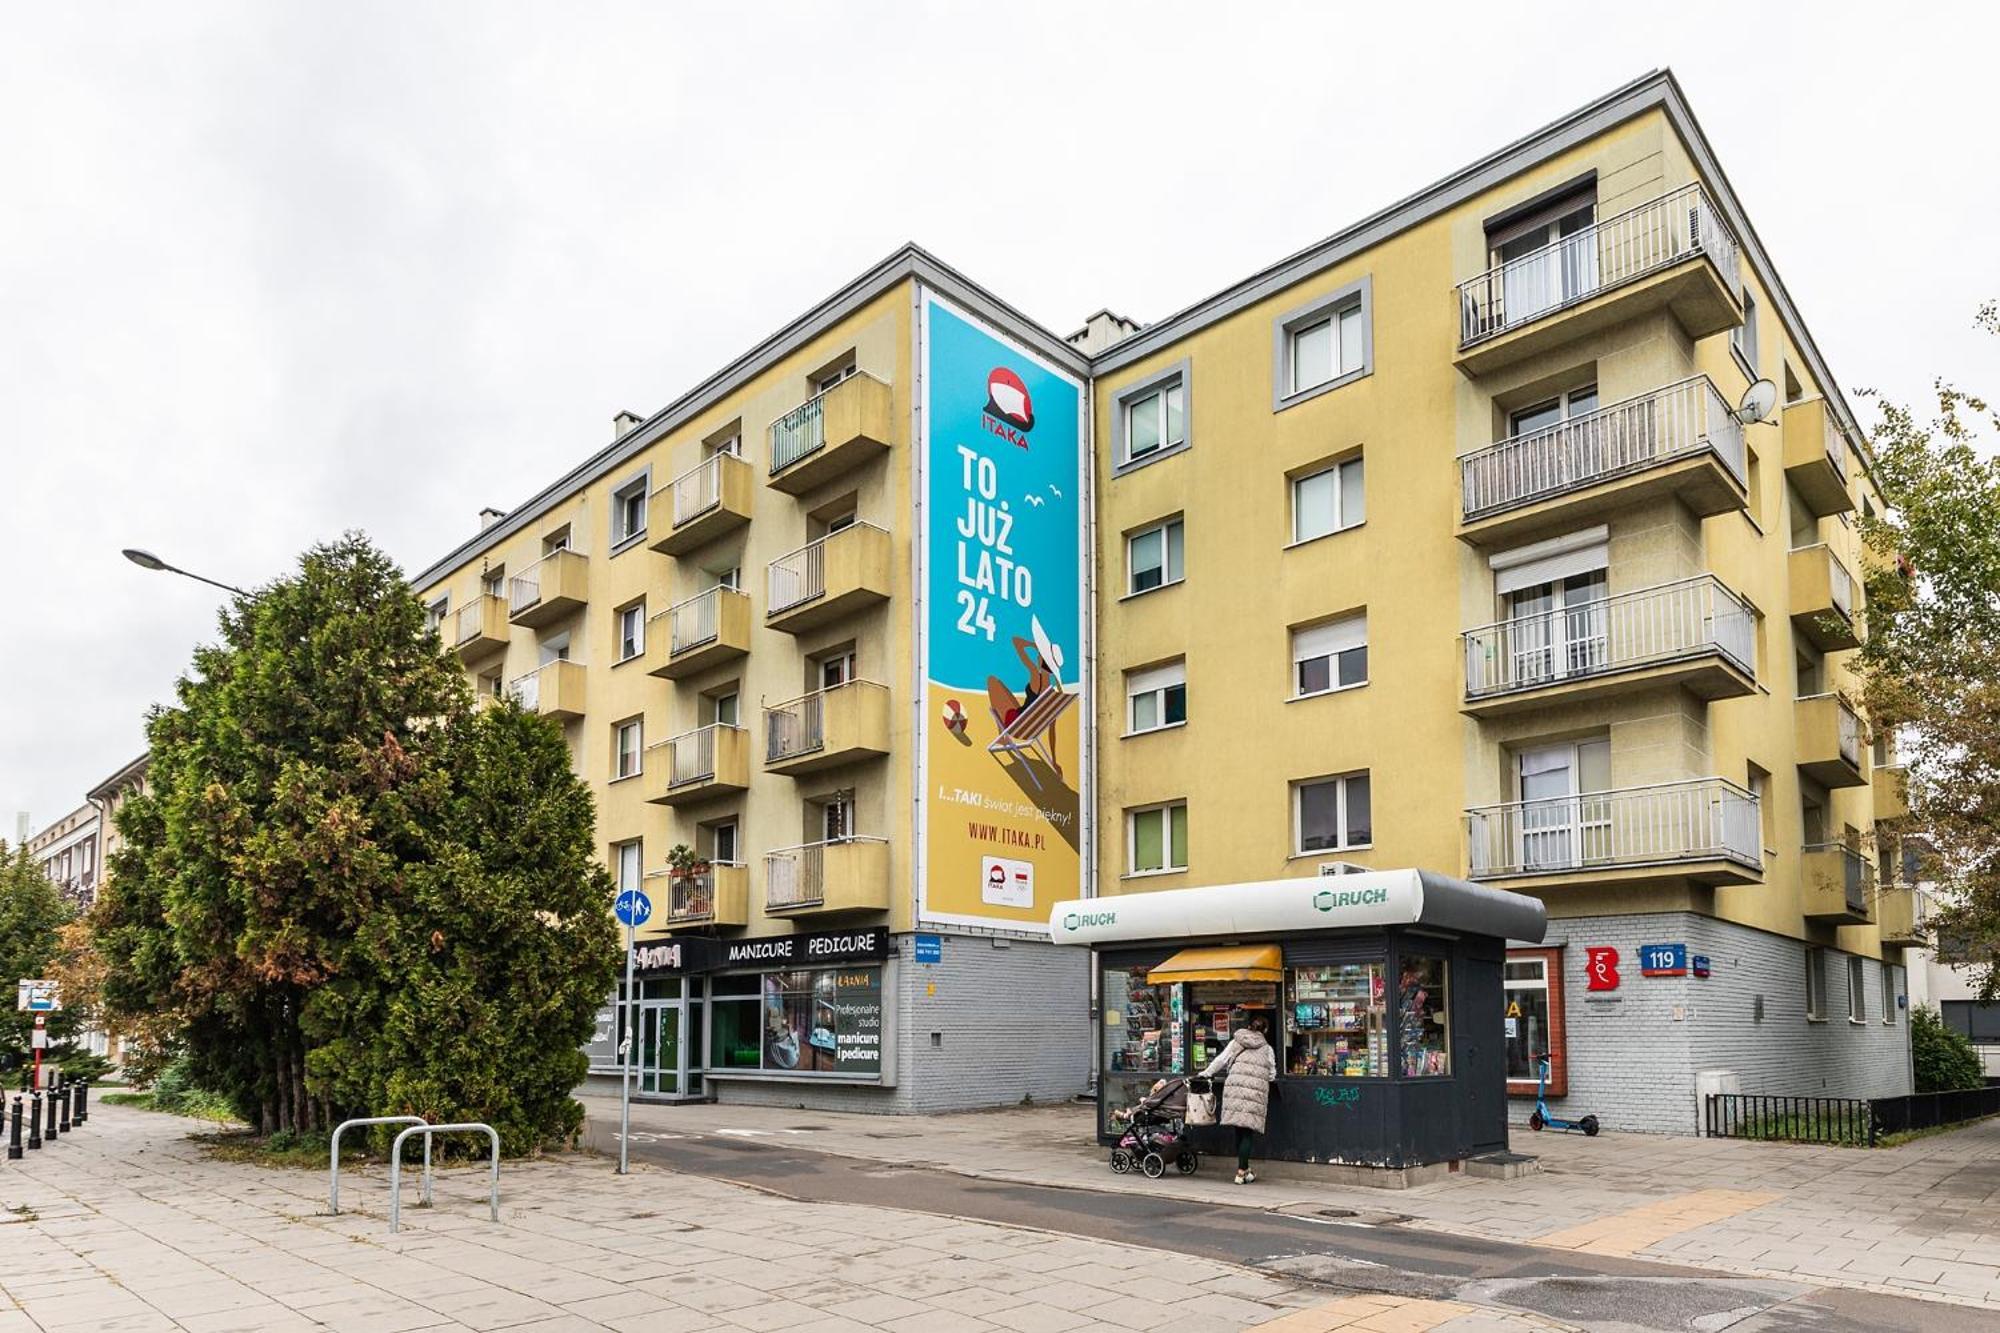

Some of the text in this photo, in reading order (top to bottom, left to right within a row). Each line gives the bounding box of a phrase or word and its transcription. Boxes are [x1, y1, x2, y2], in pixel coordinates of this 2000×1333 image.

[982, 414, 1028, 451] ITAKA
[957, 443, 997, 500] TO
[957, 496, 1013, 556] JUŻ
[957, 540, 1032, 608] LATO
[957, 589, 996, 642] 24
[984, 797, 1012, 813] świat
[1012, 804, 1034, 818] jest
[1035, 807, 1072, 826] piękny!
[968, 822, 1046, 851] WWW.ITAKA.PL
[1338, 888, 1387, 906] RUCH
[1081, 912, 1116, 927] RUCH
[728, 933, 875, 961] MANICURE PEDICURE
[1650, 951, 1675, 969] 119
[835, 1004, 880, 1016] Profesjonalne
[858, 1016, 880, 1028] studio
[837, 1032, 880, 1045] manicure
[837, 1046, 880, 1062] i pedicure
